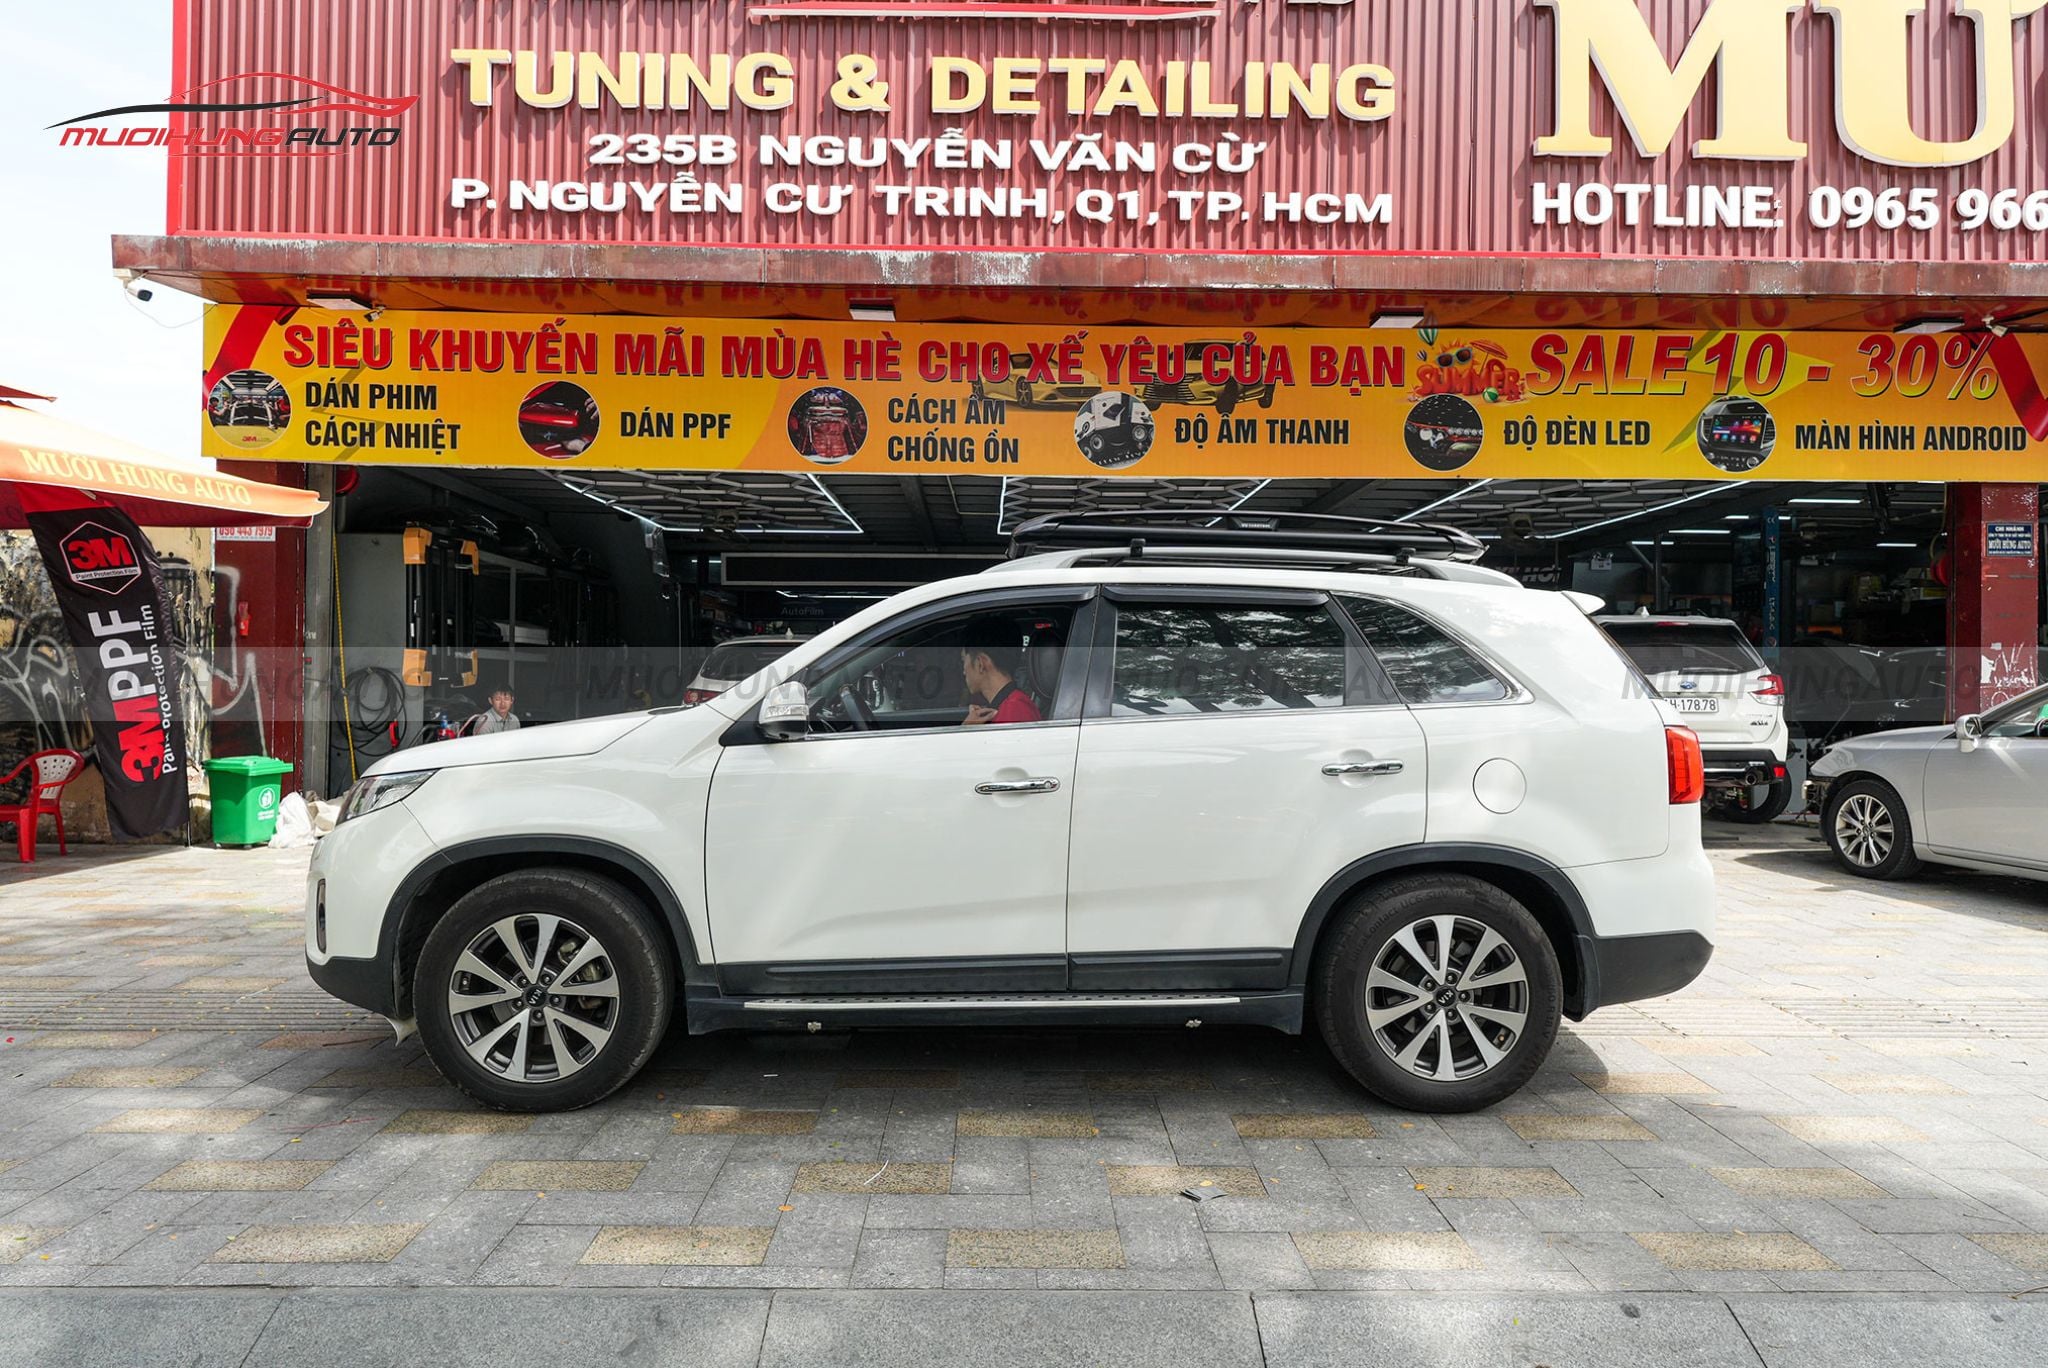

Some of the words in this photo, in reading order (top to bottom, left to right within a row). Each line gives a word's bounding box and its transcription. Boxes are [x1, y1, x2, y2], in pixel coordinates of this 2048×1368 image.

[451, 50, 794, 110] TUNING
[831, 53, 891, 112] &
[931, 57, 1395, 121] DETAILING
[588, 133, 738, 166] 235B
[759, 127, 1012, 170] NGUYỄN
[1030, 132, 1156, 173] VĂN
[1172, 132, 1267, 174] CỪ
[765, 183, 853, 216] CƯ
[1532, 182, 1783, 228] HOTLINE:
[1809, 186, 1940, 231] 0965
[283, 317, 393, 371] SIÊU
[409, 316, 597, 374] KHUYẾN
[615, 327, 703, 377] MÃI
[722, 328, 829, 379] MÙA
[843, 331, 901, 381] HÈ
[919, 340, 1011, 384] CHO
[1027, 330, 1088, 385] XẾ
[1100, 337, 1187, 386] YÊU
[1202, 331, 1294, 387] CỦA
[1311, 346, 1405, 396] BẠN
[1525, 333, 1689, 396] SALE
[1703, 333, 1787, 397] 10
[1850, 333, 1999, 400] 30%
[305, 380, 361, 409] DÁN
[369, 384, 437, 411] PHIM
[1415, 358, 1521, 397] SUMMER
[620, 412, 677, 439] DÁN
[683, 414, 732, 440] PPF
[887, 396, 958, 425] CÁCH
[965, 396, 1006, 426] ÂM
[305, 418, 375, 448] CÁCH
[384, 420, 461, 456] NHIỆT
[887, 427, 974, 464] CHỐNG
[983, 427, 1019, 465] ỒN
[1174, 413, 1209, 449] ĐỘ
[1216, 414, 1260, 446] ÂM
[1264, 419, 1350, 447] THANH
[1503, 416, 1539, 451] ĐỘ
[1546, 415, 1596, 447] ĐÈN
[1605, 420, 1651, 448] LED
[1795, 419, 1855, 450] MÀN
[1859, 419, 1918, 450] HÌNH
[1923, 426, 2027, 452] ANDROID
[194, 477, 252, 505] AUTO
[68, 538, 133, 570] 3M
[140, 604, 157, 641] Film
